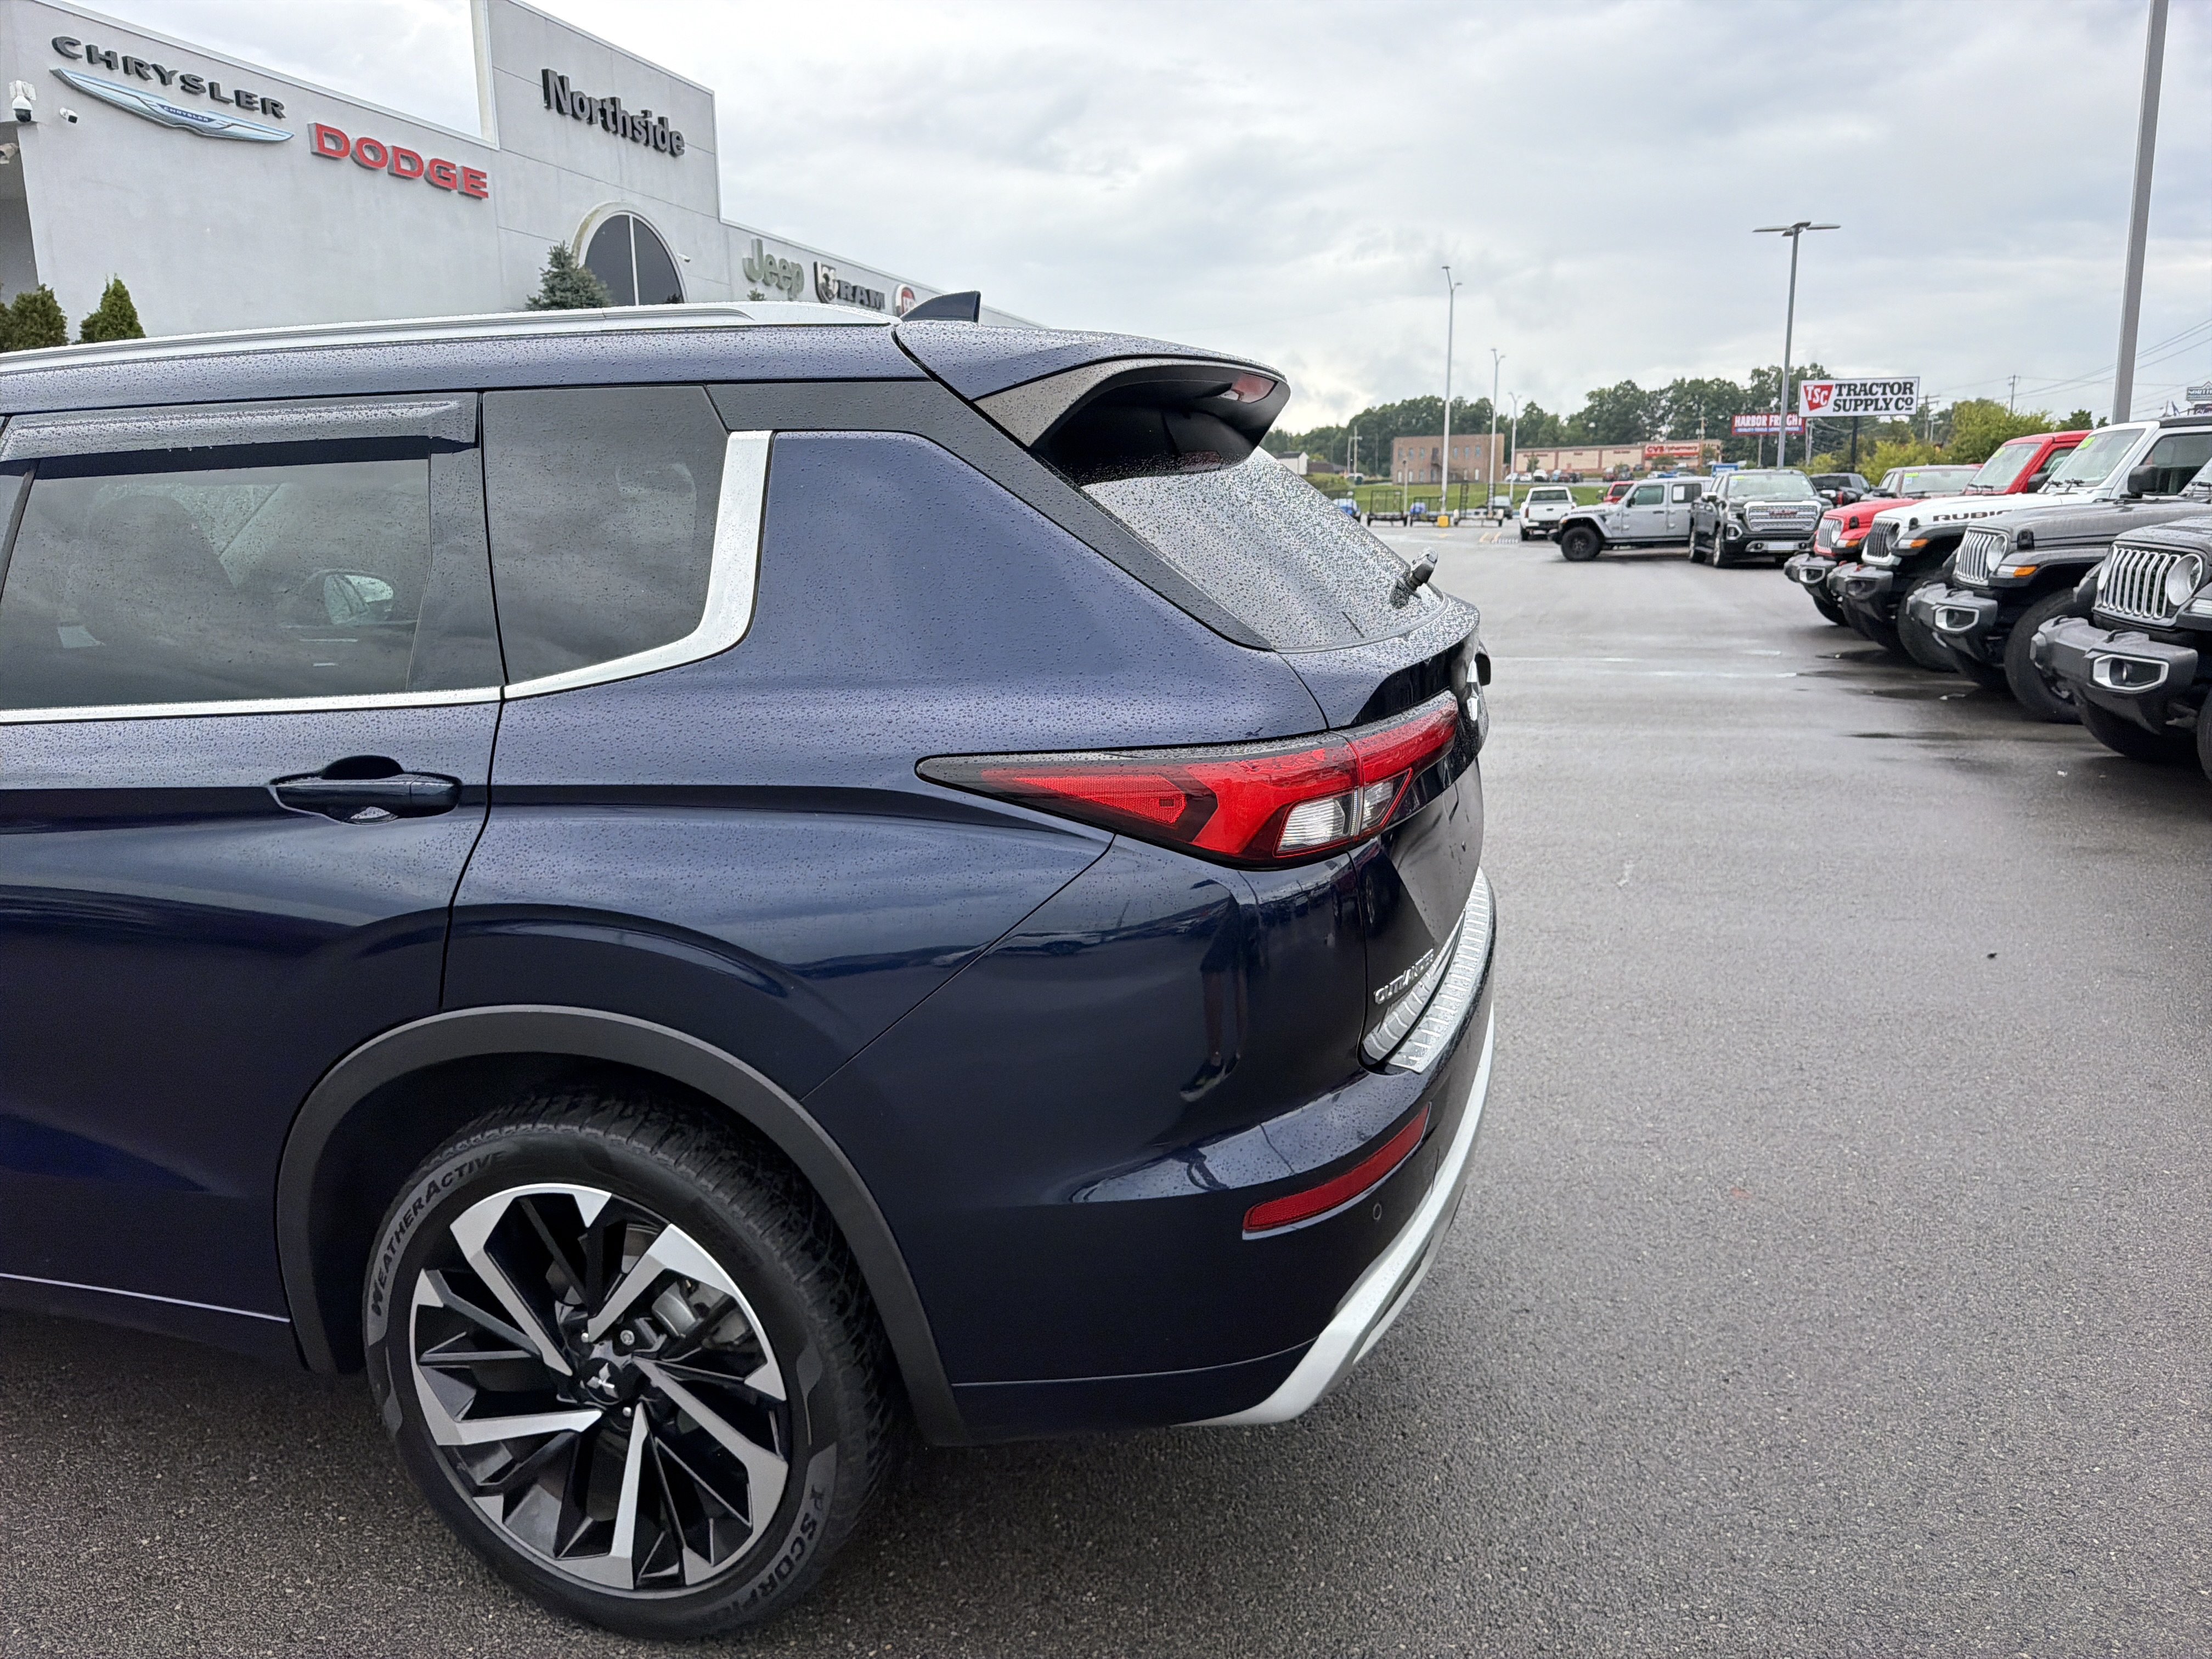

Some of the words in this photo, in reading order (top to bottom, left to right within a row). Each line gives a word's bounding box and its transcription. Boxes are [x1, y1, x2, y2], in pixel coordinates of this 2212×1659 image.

[52, 36, 286, 119] CHRYSLER
[541, 69, 685, 156] Northside
[308, 122, 488, 200] DODGE
[742, 238, 804, 300] Jeep
[837, 279, 885, 309] RAM
[1806, 386, 1829, 405] TSC
[1835, 381, 1914, 397] TRACTOR
[1832, 397, 1893, 412] SUPPLY
[1735, 415, 1768, 427] HARBOR
